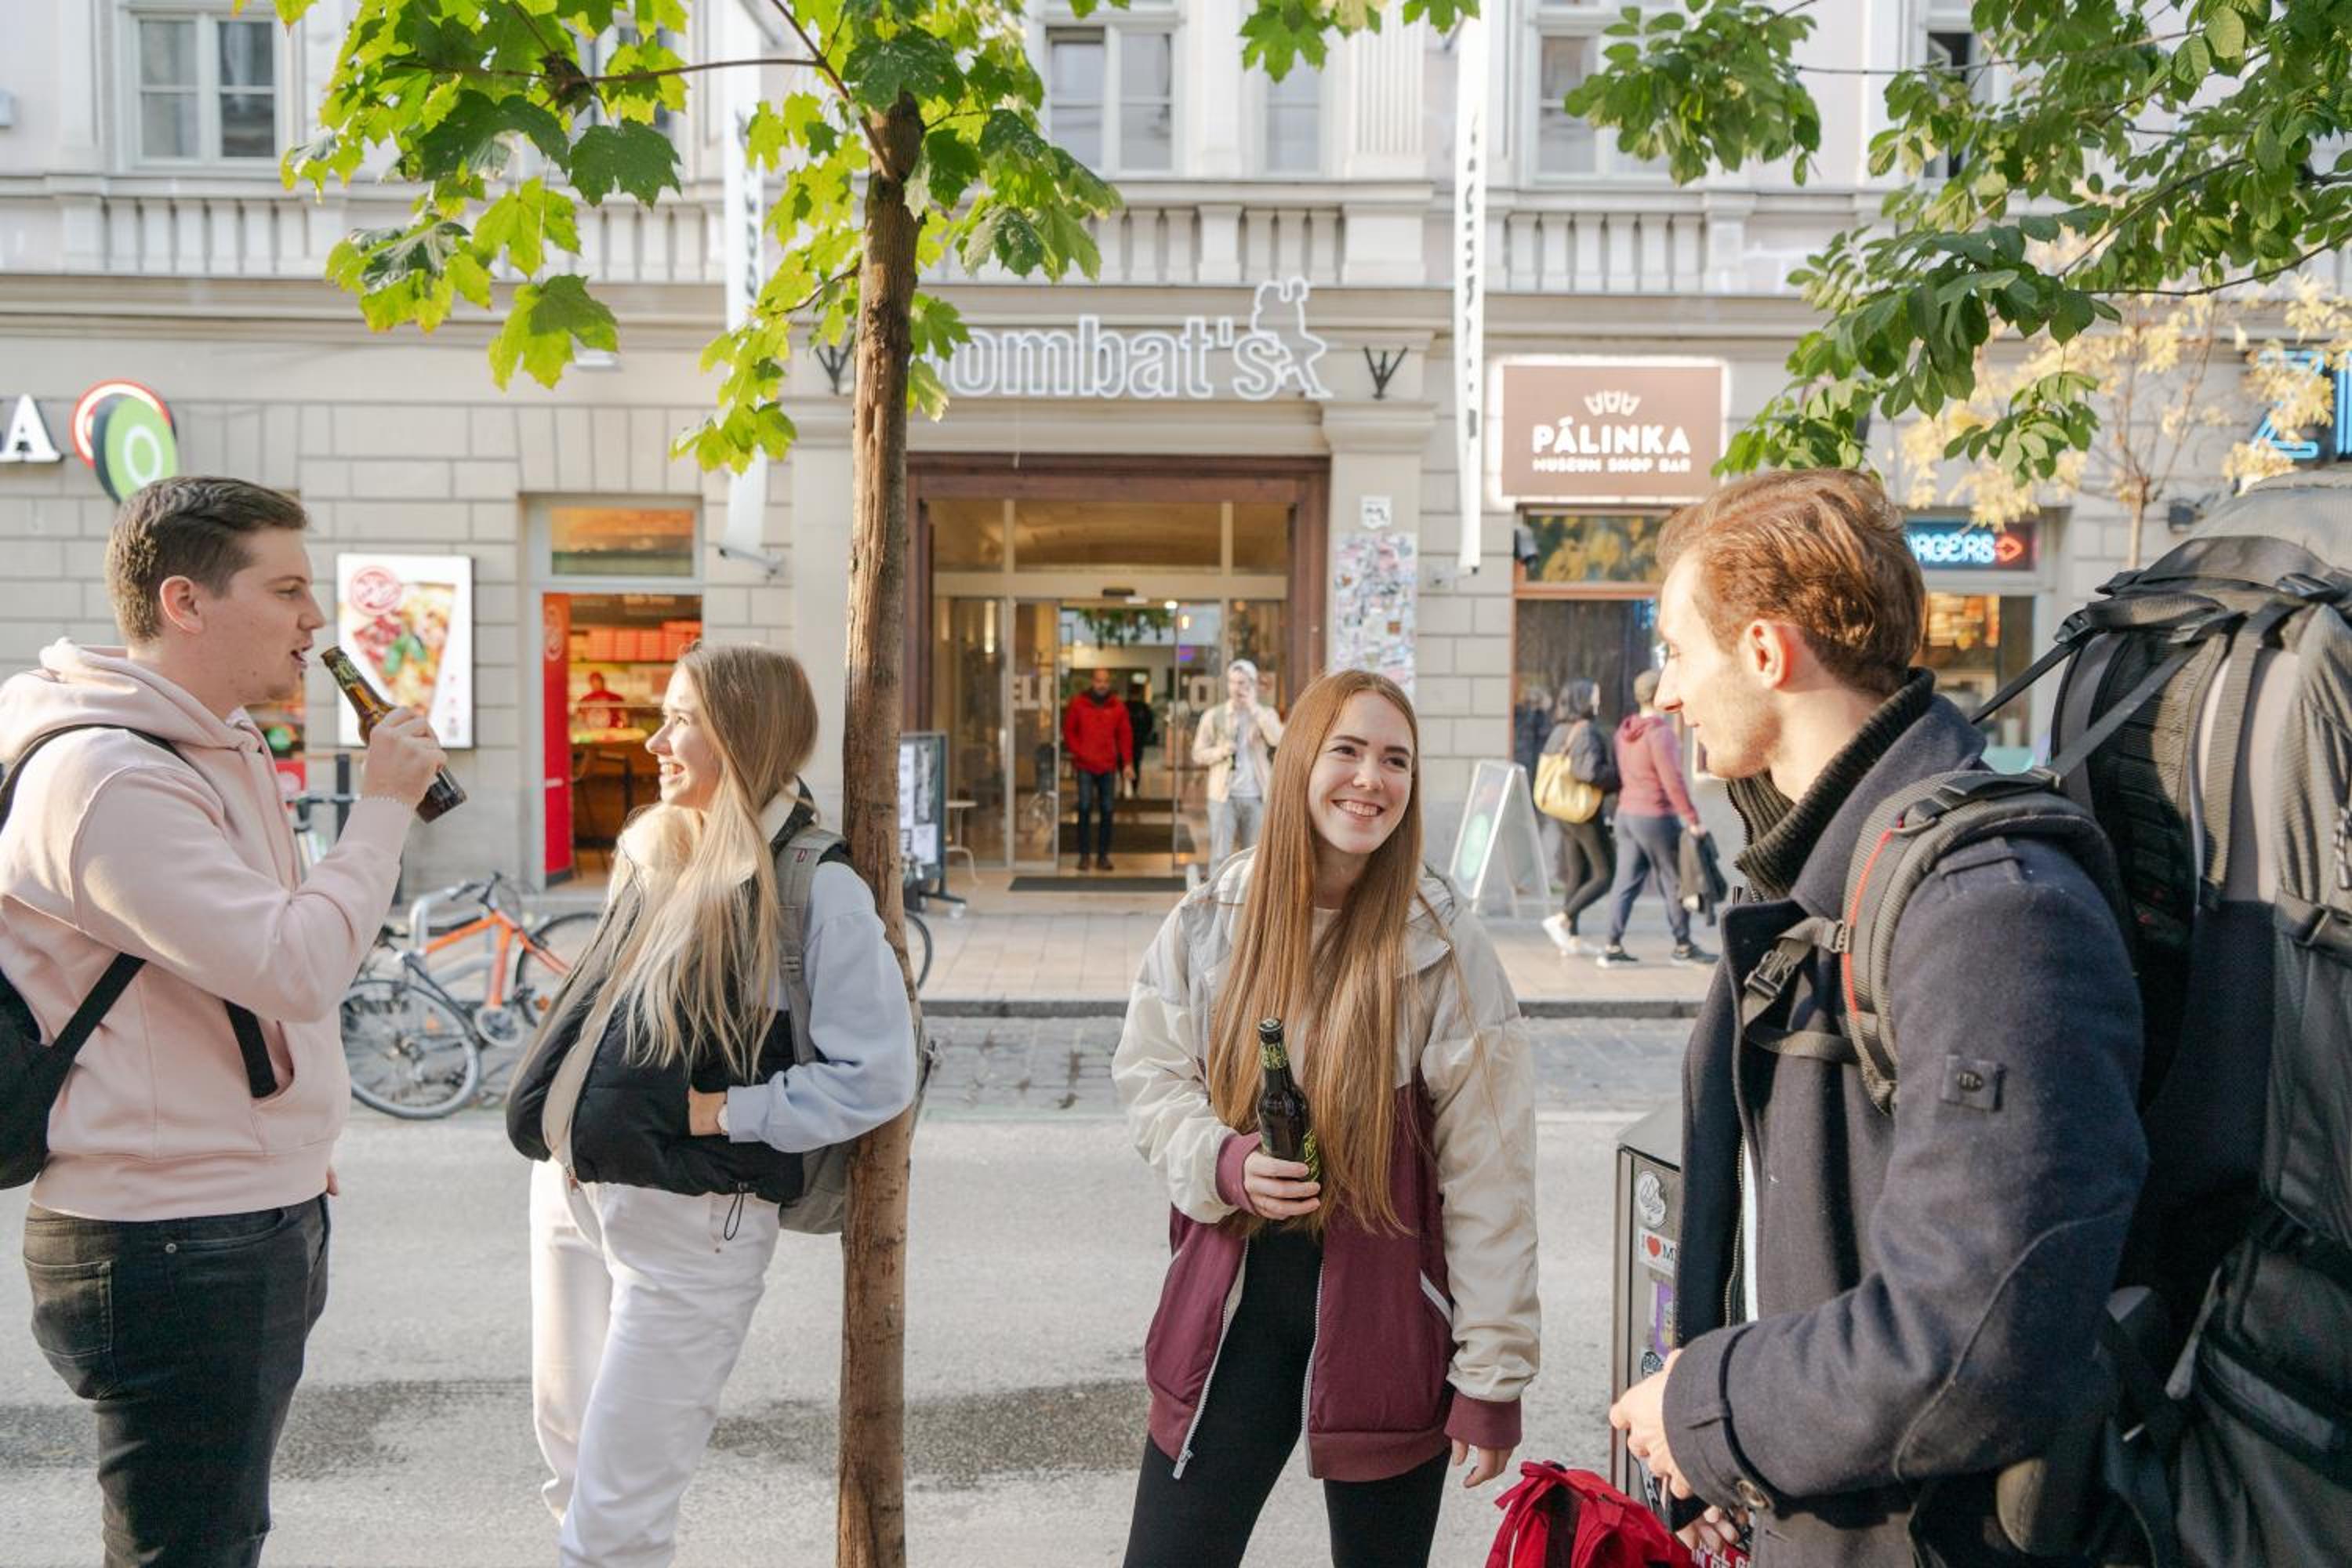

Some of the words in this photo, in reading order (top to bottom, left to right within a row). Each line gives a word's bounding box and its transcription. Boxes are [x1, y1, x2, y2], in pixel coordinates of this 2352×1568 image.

[1532, 416, 1691, 455] PÁLINKA
[1608, 457, 1653, 472] SHOP
[1658, 457, 1691, 472] BAR
